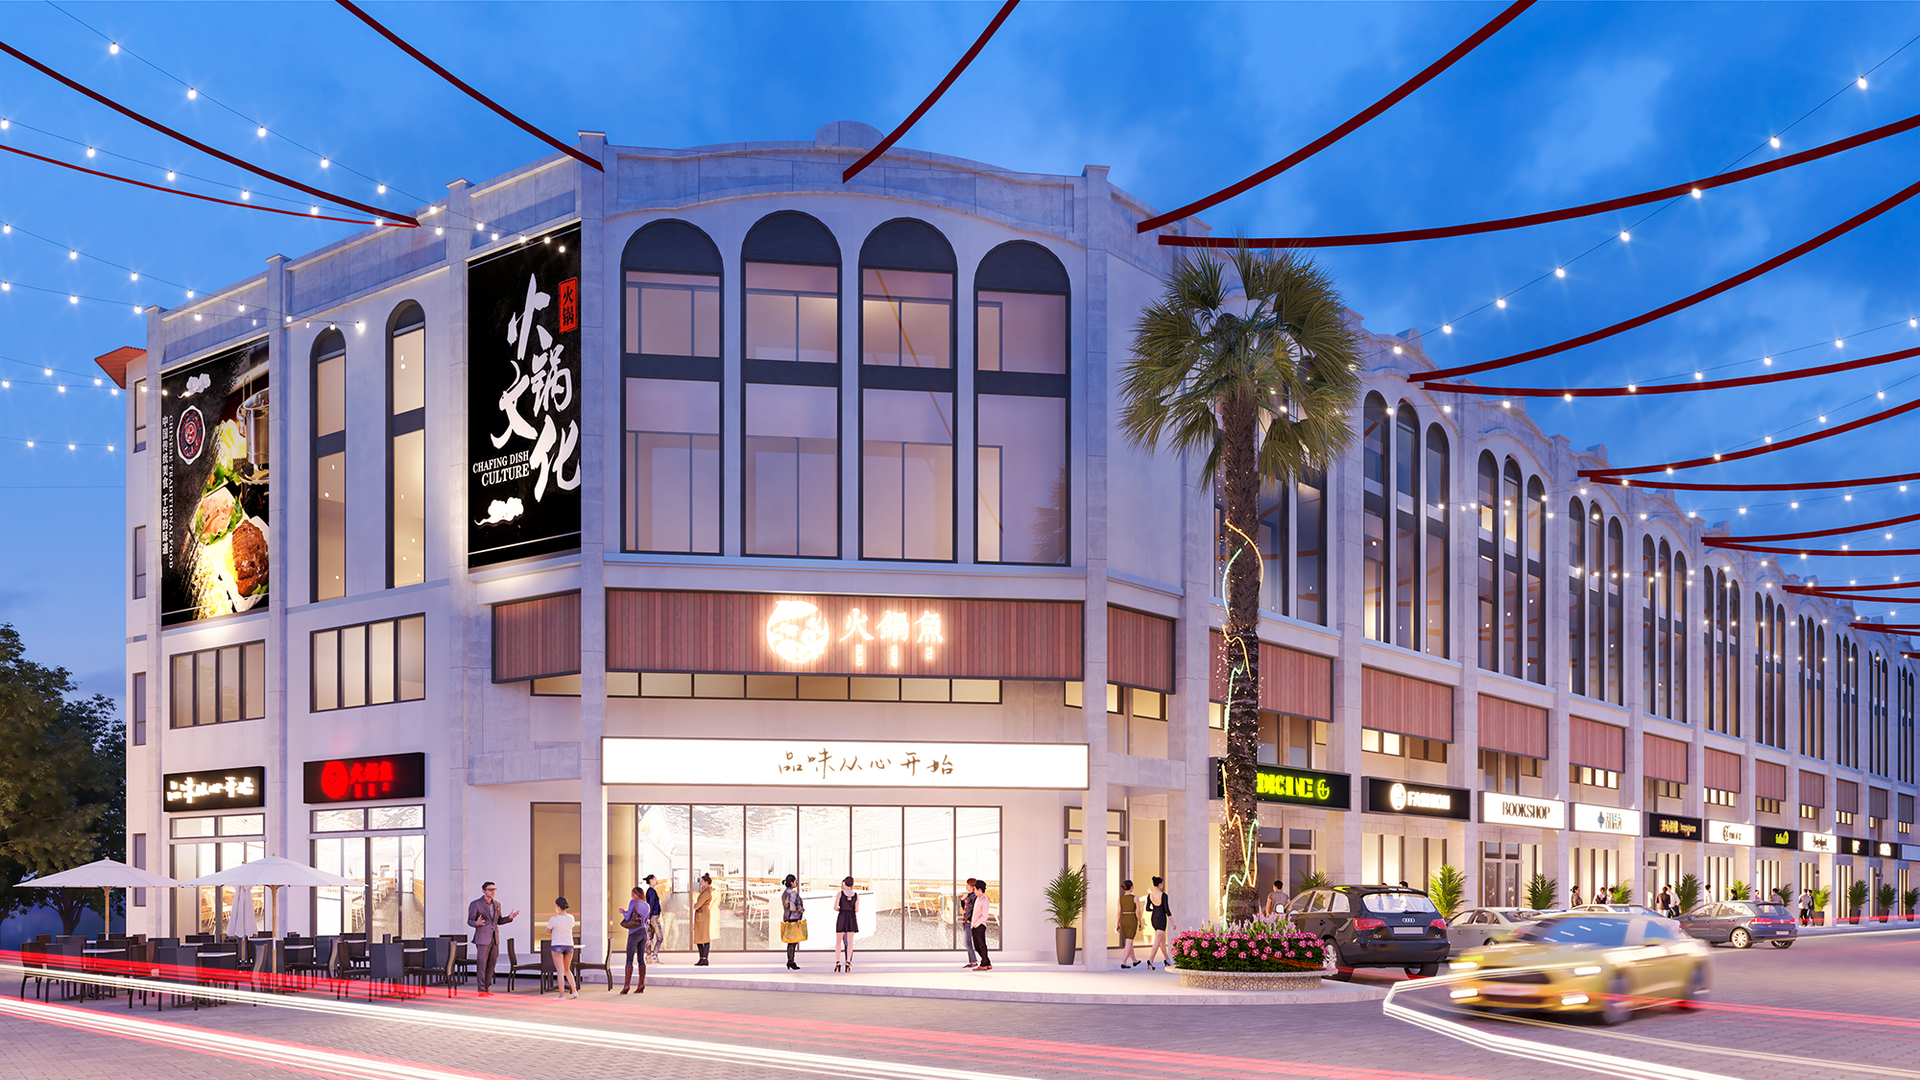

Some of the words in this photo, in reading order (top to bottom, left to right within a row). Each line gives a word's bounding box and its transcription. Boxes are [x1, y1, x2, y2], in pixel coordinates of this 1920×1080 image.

[561, 285, 575, 326] 火锅
[472, 455, 508, 474] CHAFING
[509, 449, 530, 467] DISH
[481, 462, 530, 487] CULTURE
[855, 644, 864, 666] HUO
[778, 747, 954, 779] 品味从心开始
[1256, 772, 1314, 798] DICINE
[1502, 801, 1551, 820] BOOKSHOP
